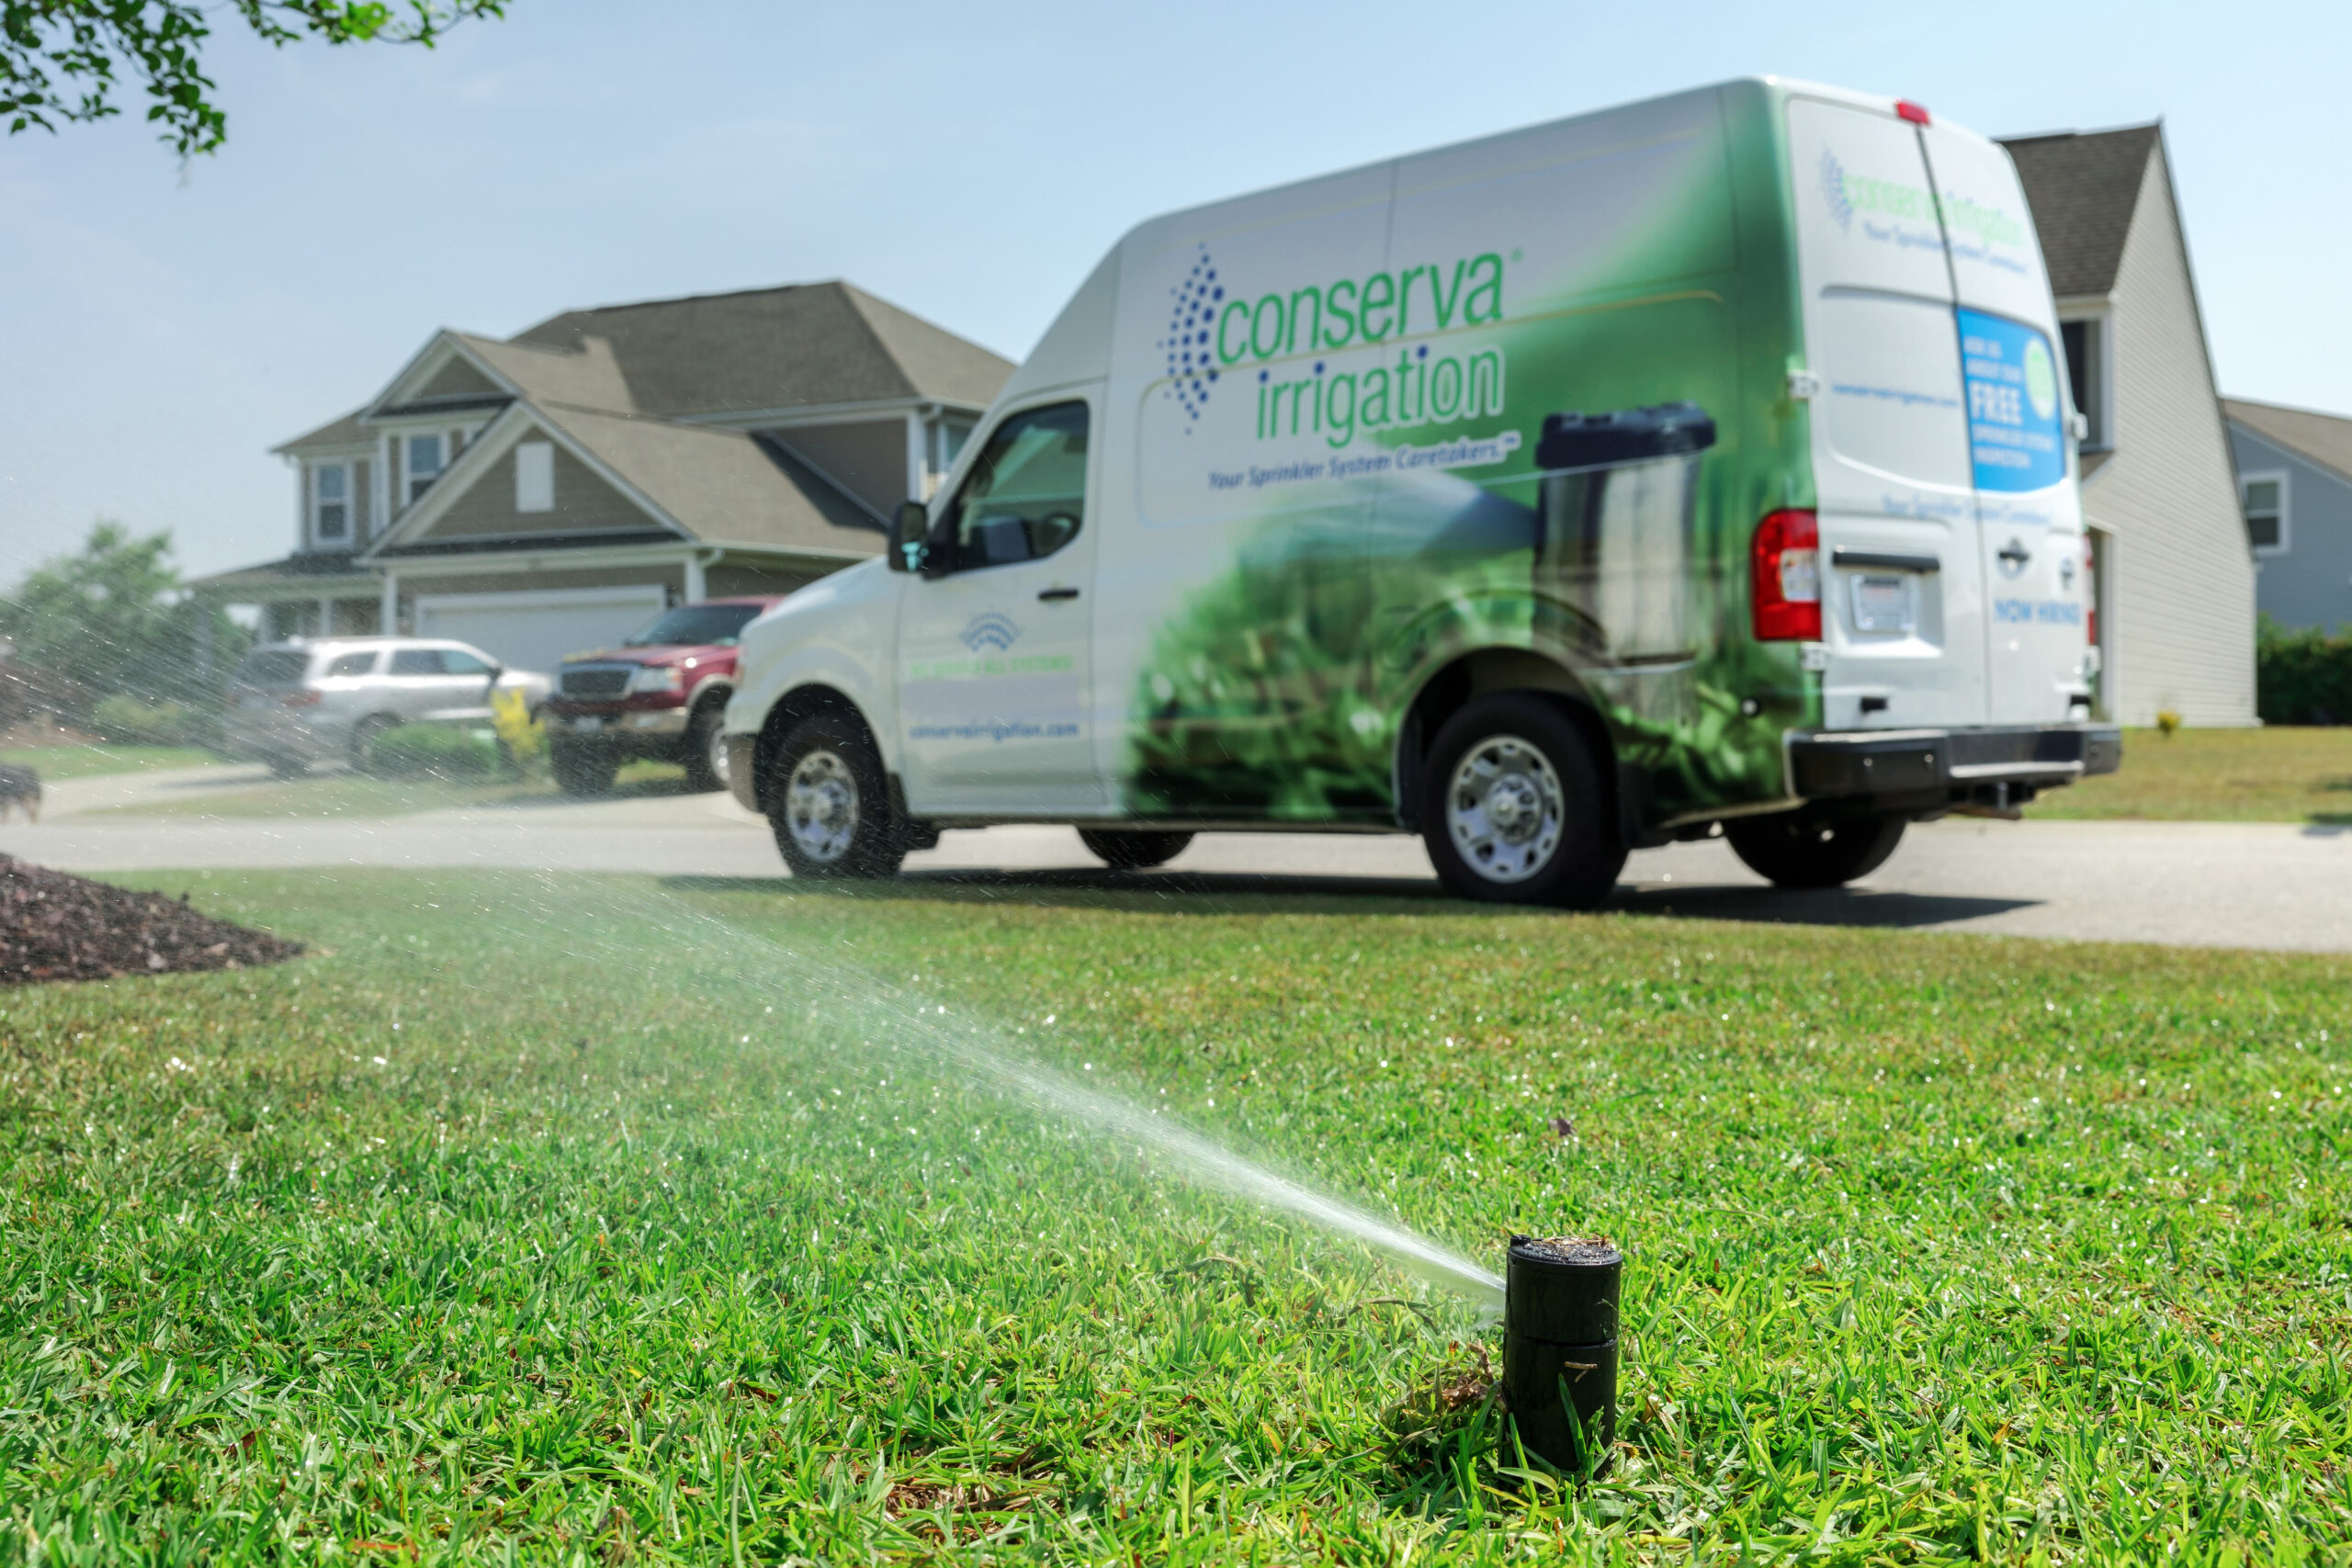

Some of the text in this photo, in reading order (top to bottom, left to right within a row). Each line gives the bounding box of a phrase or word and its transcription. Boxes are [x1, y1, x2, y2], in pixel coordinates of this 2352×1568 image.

[1257, 344, 1501, 448] irrigation
[1968, 380, 2023, 426] FREE
[1208, 470, 1244, 490] Your
[1248, 462, 1324, 488] Sprinkler
[1329, 456, 1392, 479] System
[1994, 599, 2080, 626] NOW HIRING
